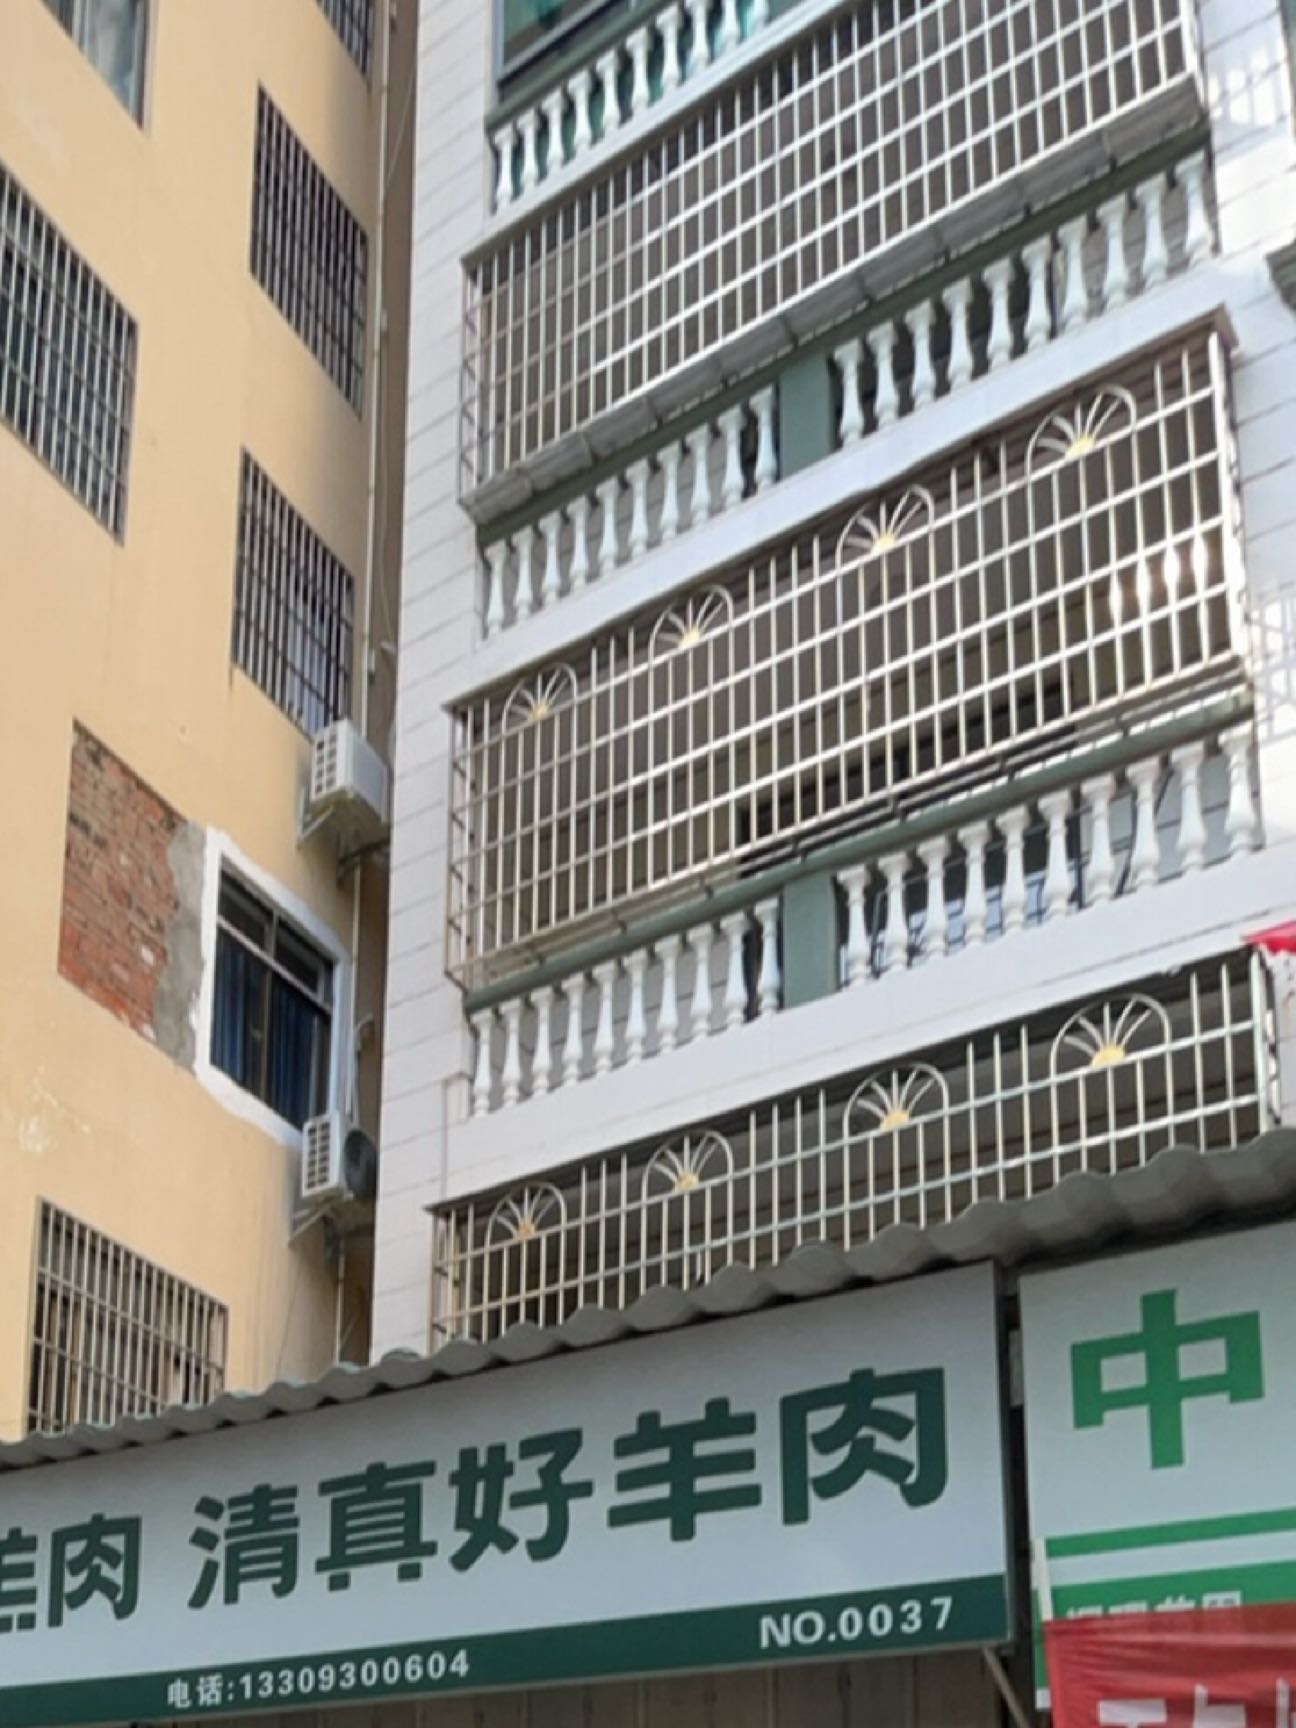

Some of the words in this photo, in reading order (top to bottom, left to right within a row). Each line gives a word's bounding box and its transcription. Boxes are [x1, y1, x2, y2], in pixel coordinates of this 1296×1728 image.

[1071, 1288, 1265, 1470] 中
[187, 1367, 948, 1610] 清真好羊肉
[760, 1596, 955, 1650] NO.0037
